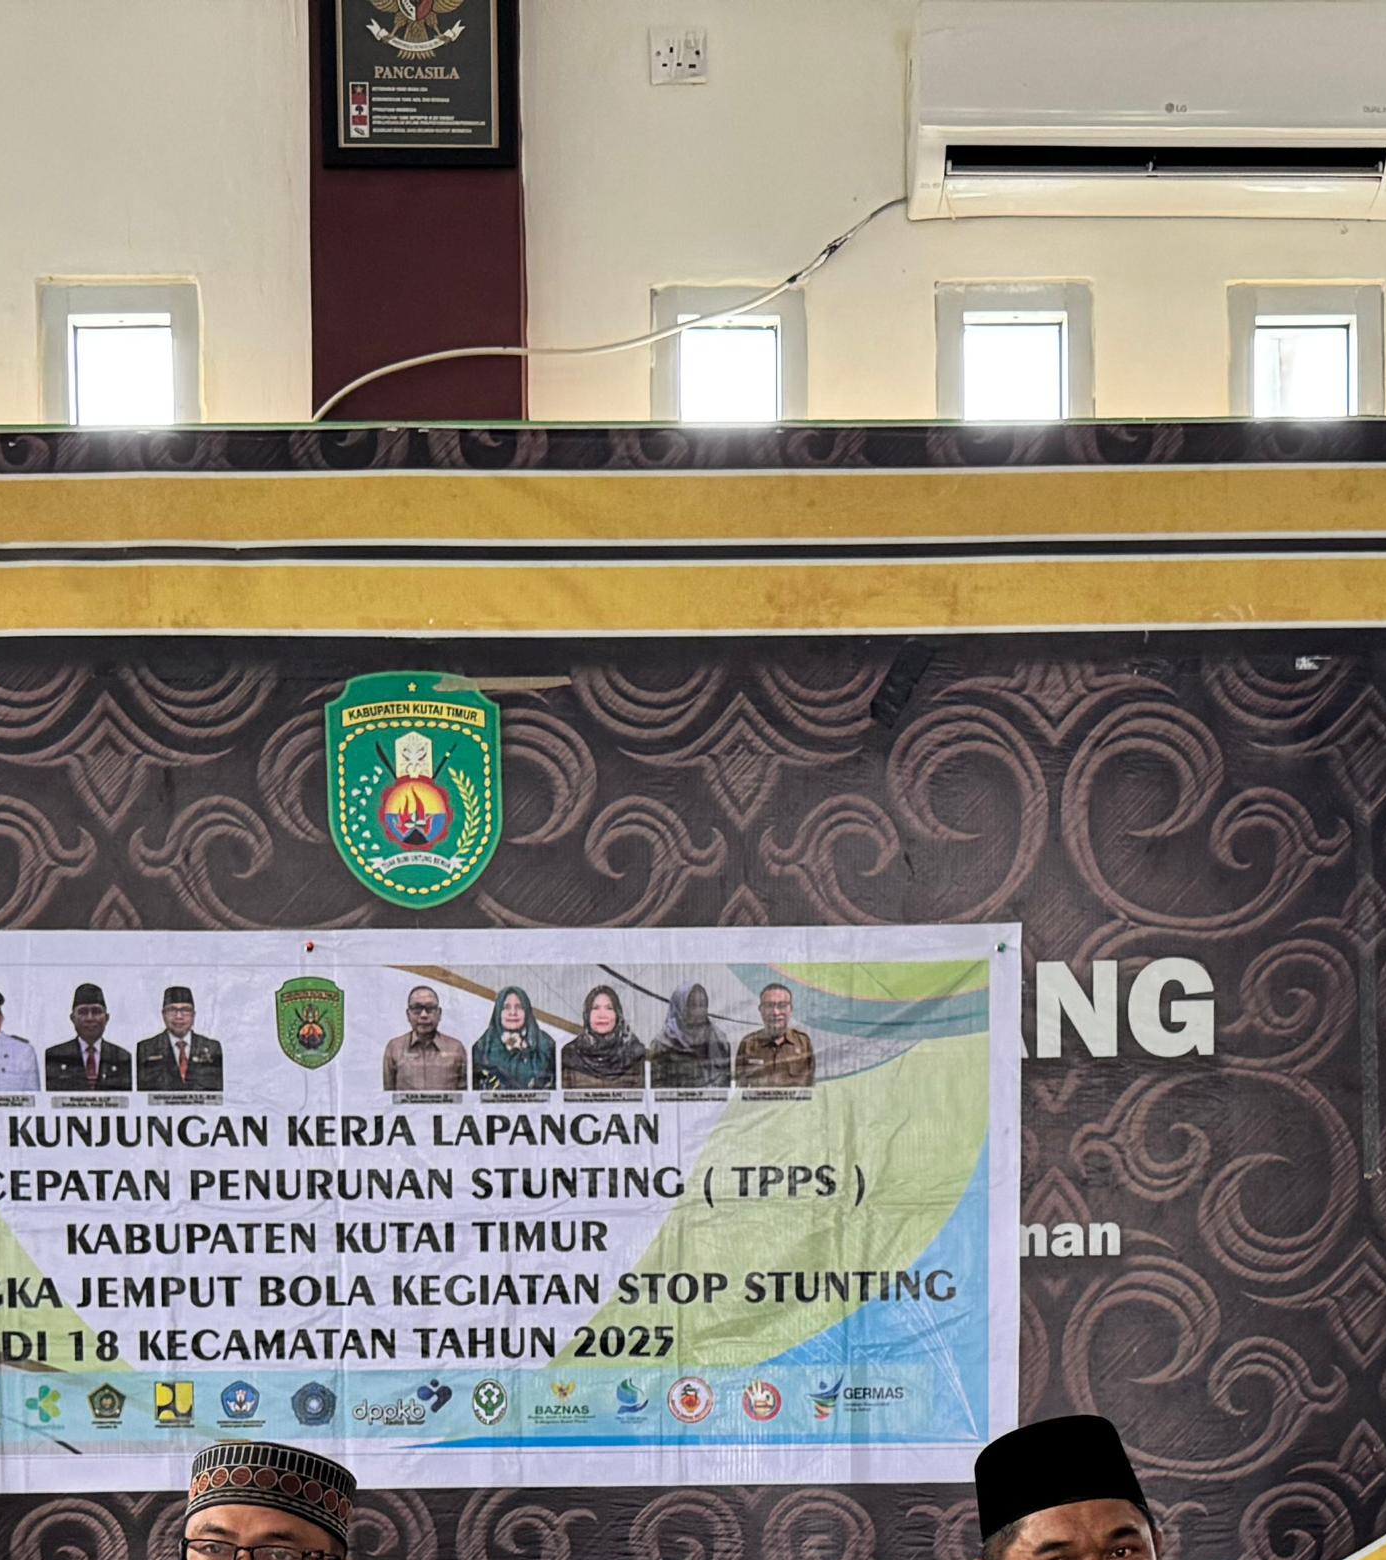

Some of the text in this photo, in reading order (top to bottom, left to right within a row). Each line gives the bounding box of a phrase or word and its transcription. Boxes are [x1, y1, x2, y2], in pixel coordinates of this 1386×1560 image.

[374, 66, 460, 80] PANCASILA
[348, 703, 478, 721] KABUPATEN KUTAI TIMUR
[1020, 957, 1215, 1058] NG
[10, 1114, 659, 1147] KUNJUNGAN KERJA LAPANGAN
[191, 1169, 452, 1200] PENURUNAN
[472, 1167, 684, 1199] STUNTING
[732, 1165, 836, 1197] TPPS
[68, 1222, 608, 1254] KABUPATEN KUTAI TIMUR
[76, 1277, 242, 1308] JEMPUT
[260, 1276, 375, 1306] BOLA
[394, 1275, 599, 1306] KEGIATAN
[618, 1273, 727, 1304] STOP
[745, 1271, 956, 1302] STUNTING
[2, 1326, 673, 1363] DI 18 KECAMATAN TAHUN 2025
[843, 1386, 904, 1400] GERMAS
[535, 1405, 590, 1415] BAZNAS
